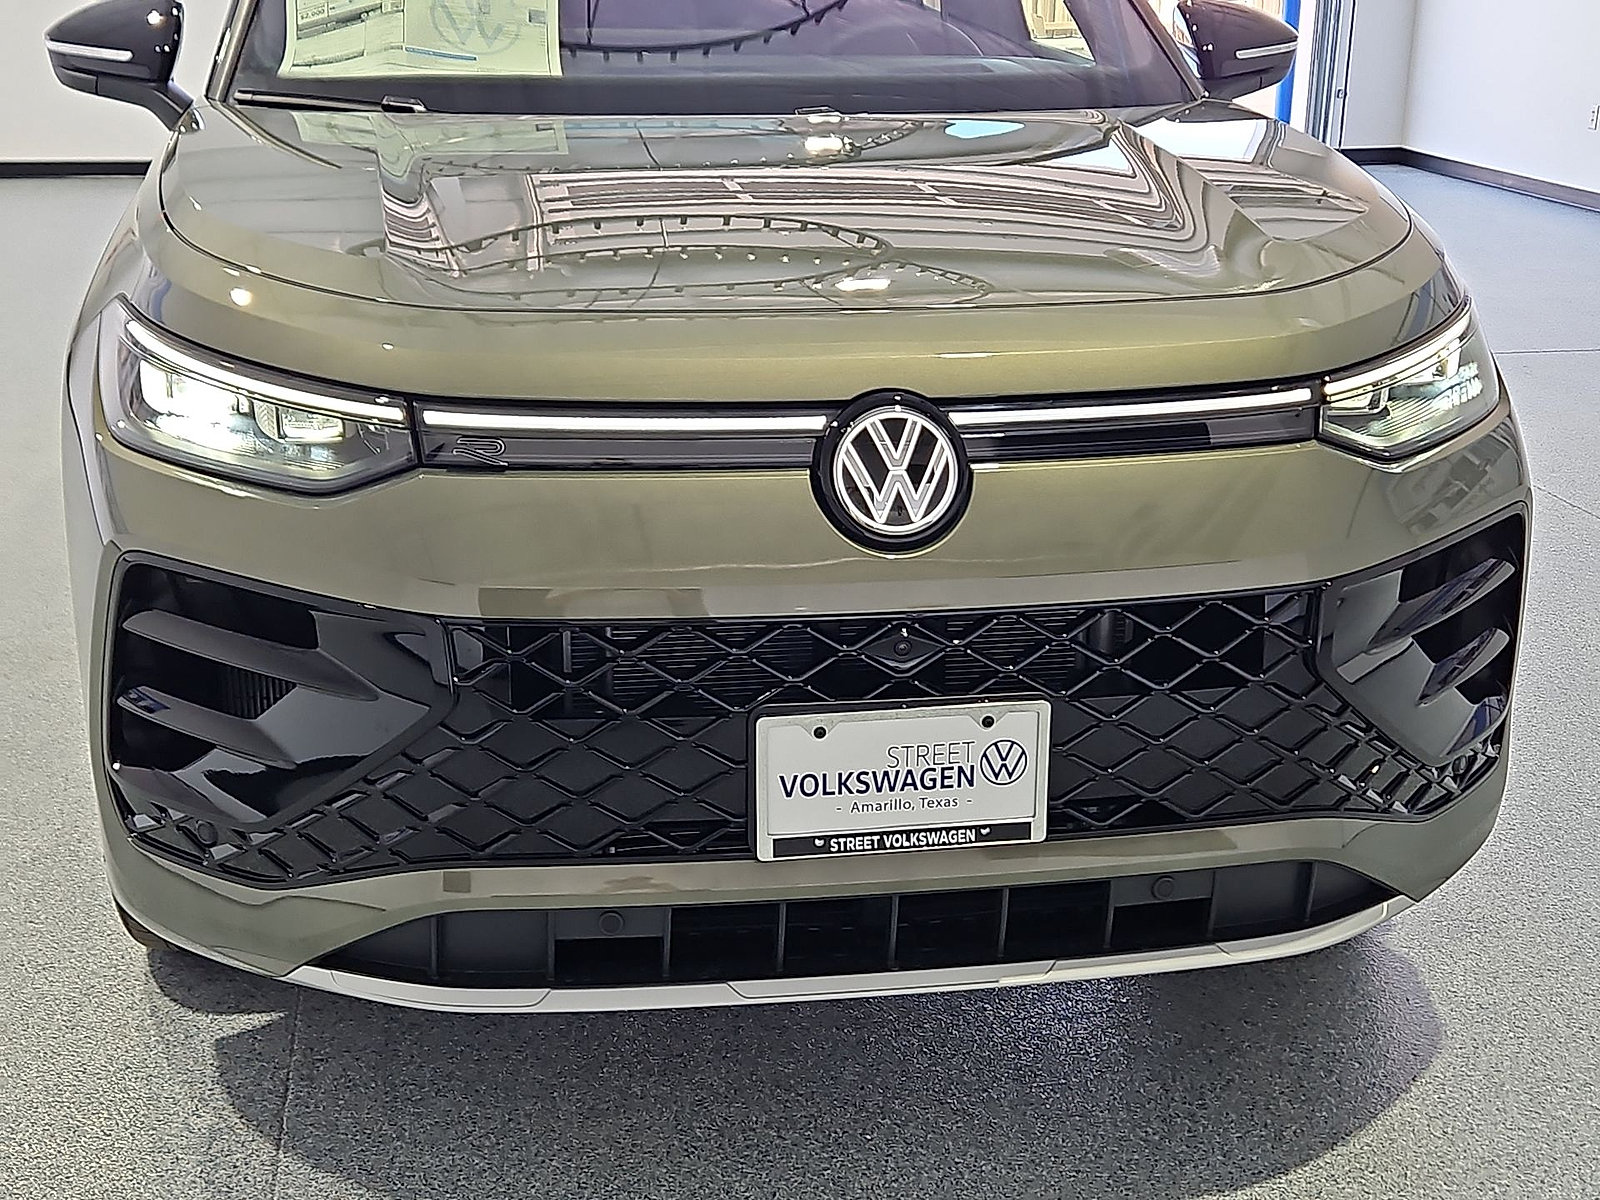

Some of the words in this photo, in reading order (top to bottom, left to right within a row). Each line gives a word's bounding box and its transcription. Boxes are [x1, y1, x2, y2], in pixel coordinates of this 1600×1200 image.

[887, 740, 976, 769] STREET
[779, 764, 976, 798] VOLKSWAGEN
[850, 798, 916, 815] Amarillo,
[918, 796, 959, 810] Texas
[829, 833, 879, 853] STREET
[883, 829, 976, 849] VOLKSWAGEN
